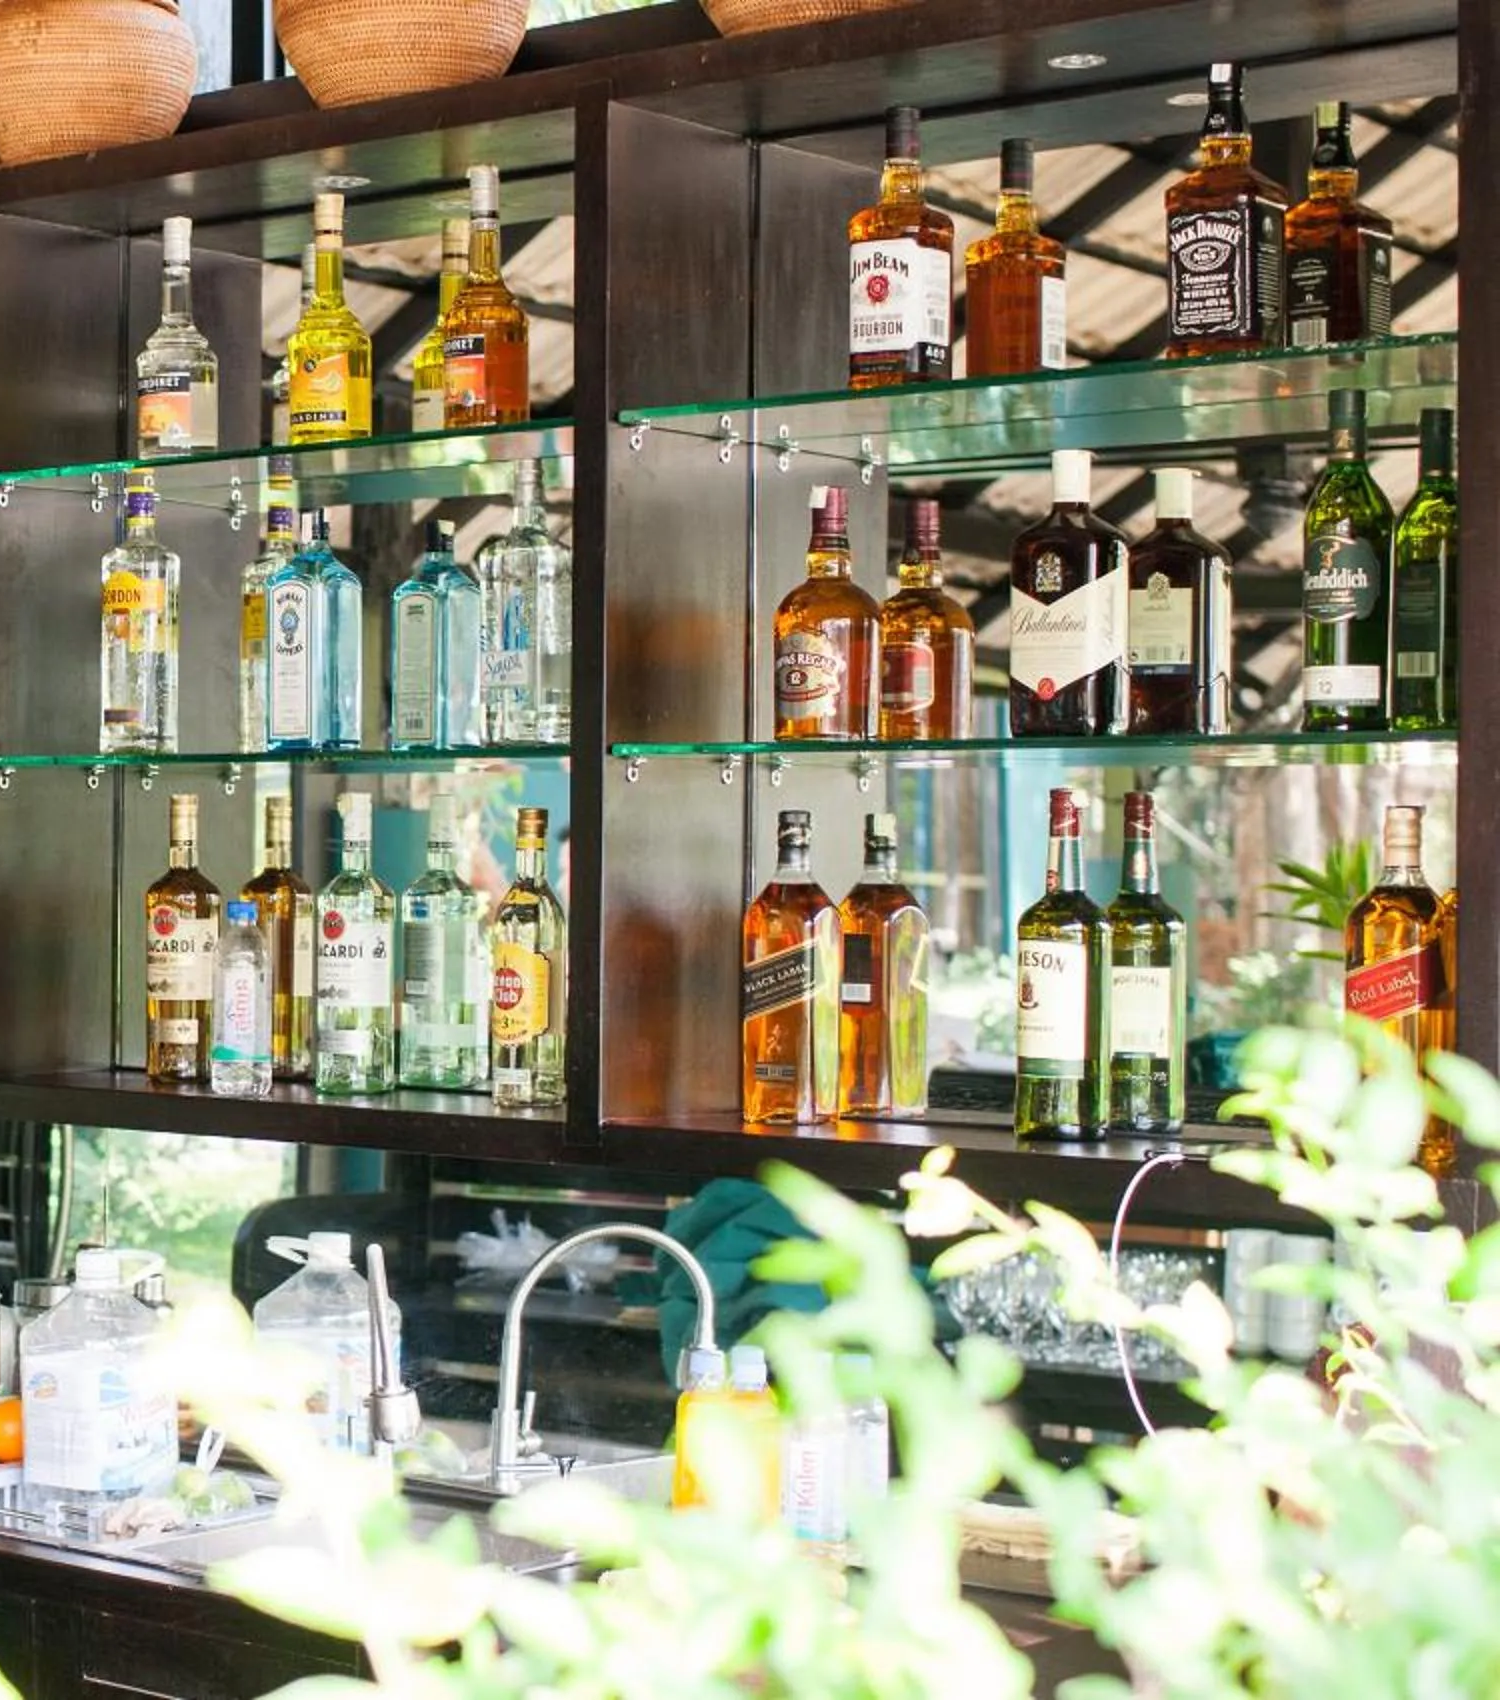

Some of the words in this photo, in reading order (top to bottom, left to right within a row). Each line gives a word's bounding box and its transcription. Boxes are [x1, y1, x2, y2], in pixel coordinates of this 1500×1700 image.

[1170, 226, 1197, 253] JACK
[851, 257, 871, 284] JIM
[873, 251, 909, 278] BEAM
[853, 321, 903, 339] BOURBON
[1304, 567, 1369, 591] lenfiddich
[1019, 951, 1064, 974] ESON
[1349, 987, 1377, 1006] Red
[1379, 970, 1421, 993] Label
